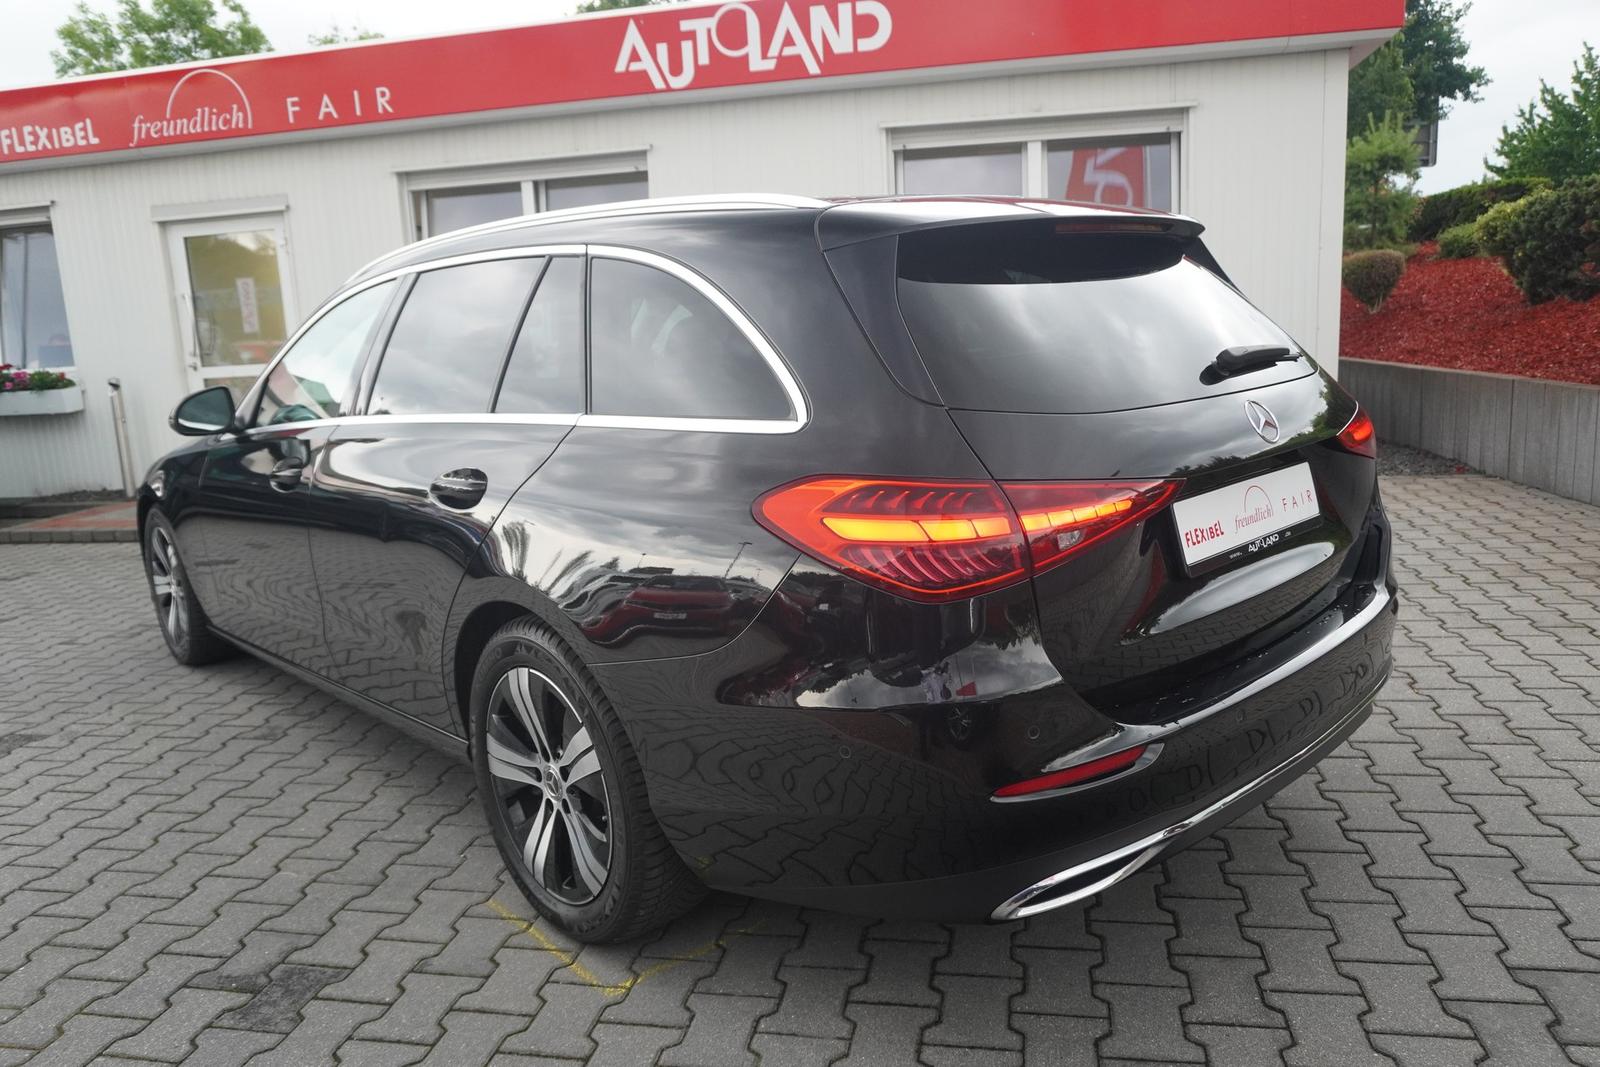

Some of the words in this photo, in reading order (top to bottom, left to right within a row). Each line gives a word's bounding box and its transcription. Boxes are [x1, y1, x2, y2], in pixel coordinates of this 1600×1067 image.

[614, 0, 893, 90] AUTOLAND
[1, 117, 100, 155] FLEXIBEL
[129, 103, 244, 148] freundlich
[286, 86, 394, 124] FAIR
[1184, 520, 1225, 548] FLEXIBEL
[1234, 504, 1272, 534] freundlich
[1281, 489, 1313, 512] FAIR
